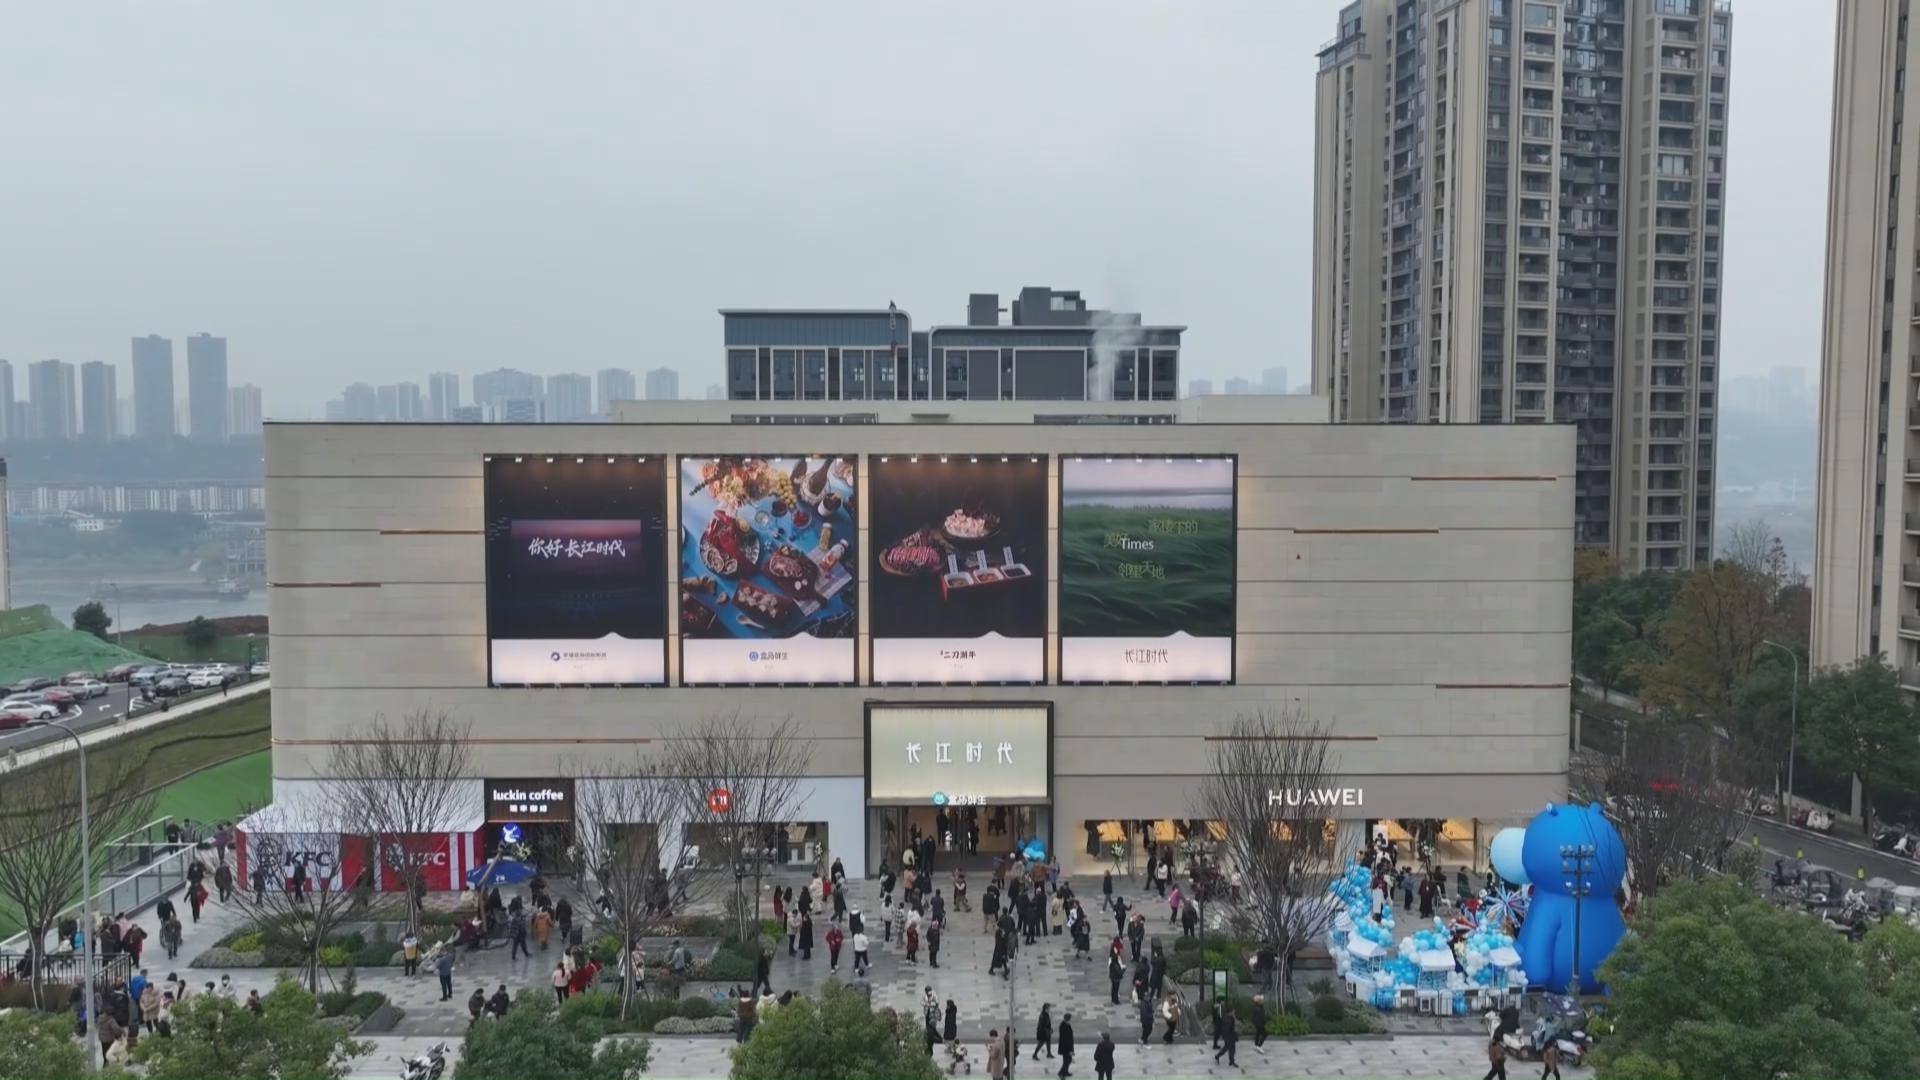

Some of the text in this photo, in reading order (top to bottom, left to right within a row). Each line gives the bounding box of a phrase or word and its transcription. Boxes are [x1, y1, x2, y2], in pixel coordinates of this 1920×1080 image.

[1120, 538, 1154, 550] Times
[1124, 648, 1169, 664] 长江时代
[906, 741, 1013, 764] 长江时代
[493, 789, 564, 801] luckin coffee
[1268, 788, 1363, 806] HUAWEI
[285, 851, 332, 867] KFC
